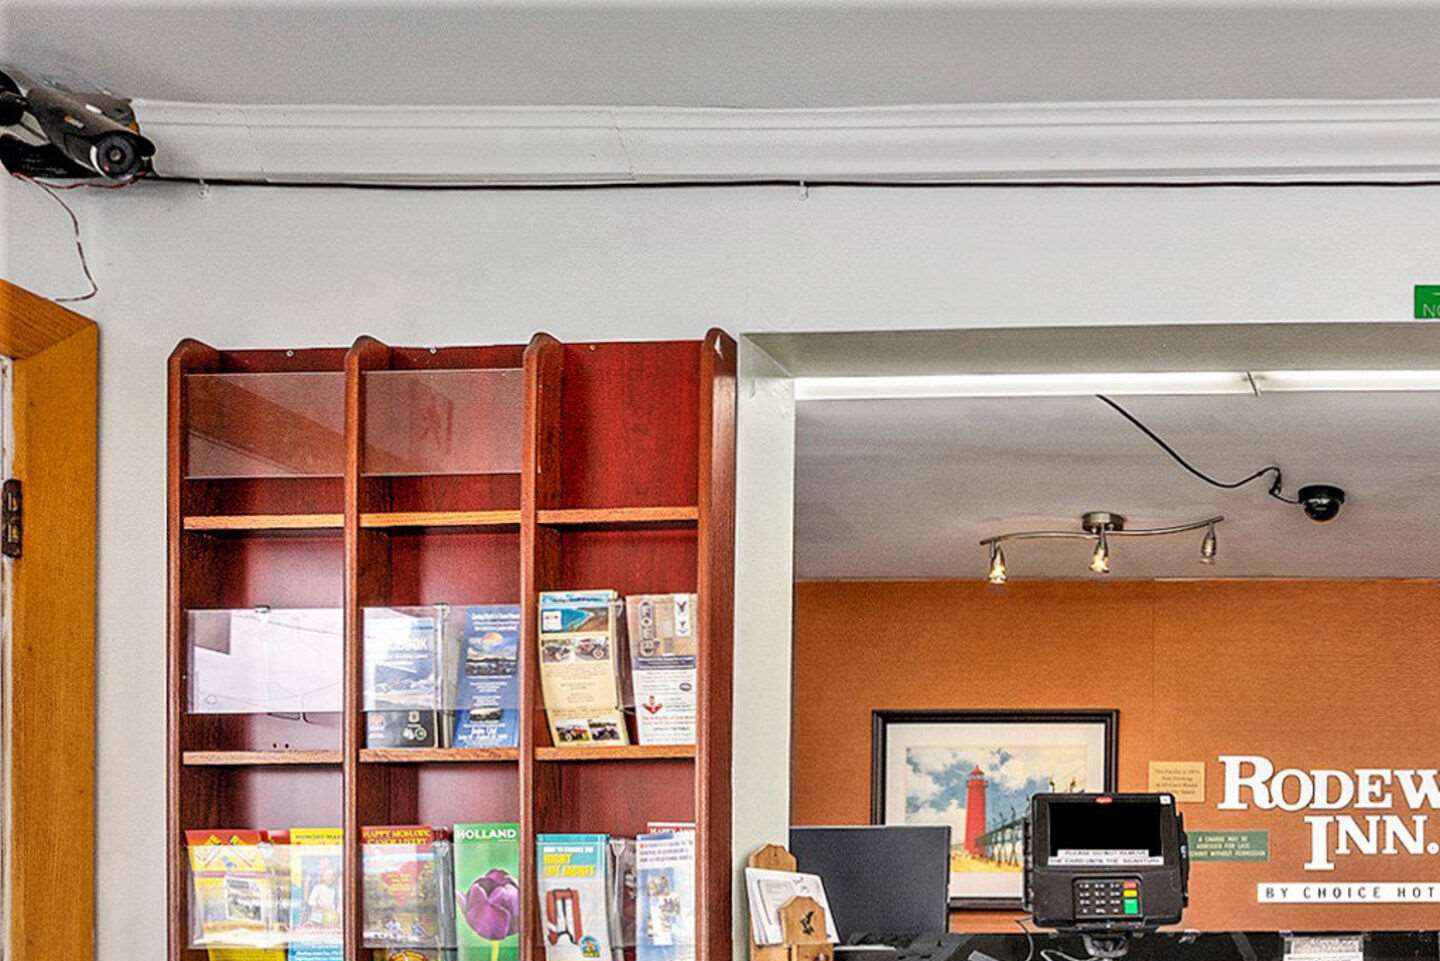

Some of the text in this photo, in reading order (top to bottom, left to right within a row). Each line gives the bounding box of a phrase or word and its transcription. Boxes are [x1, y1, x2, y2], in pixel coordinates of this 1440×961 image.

[456, 829, 517, 840] HOLLAND
[1265, 886, 1289, 899] BY
[1302, 886, 1382, 899] CHOICE
